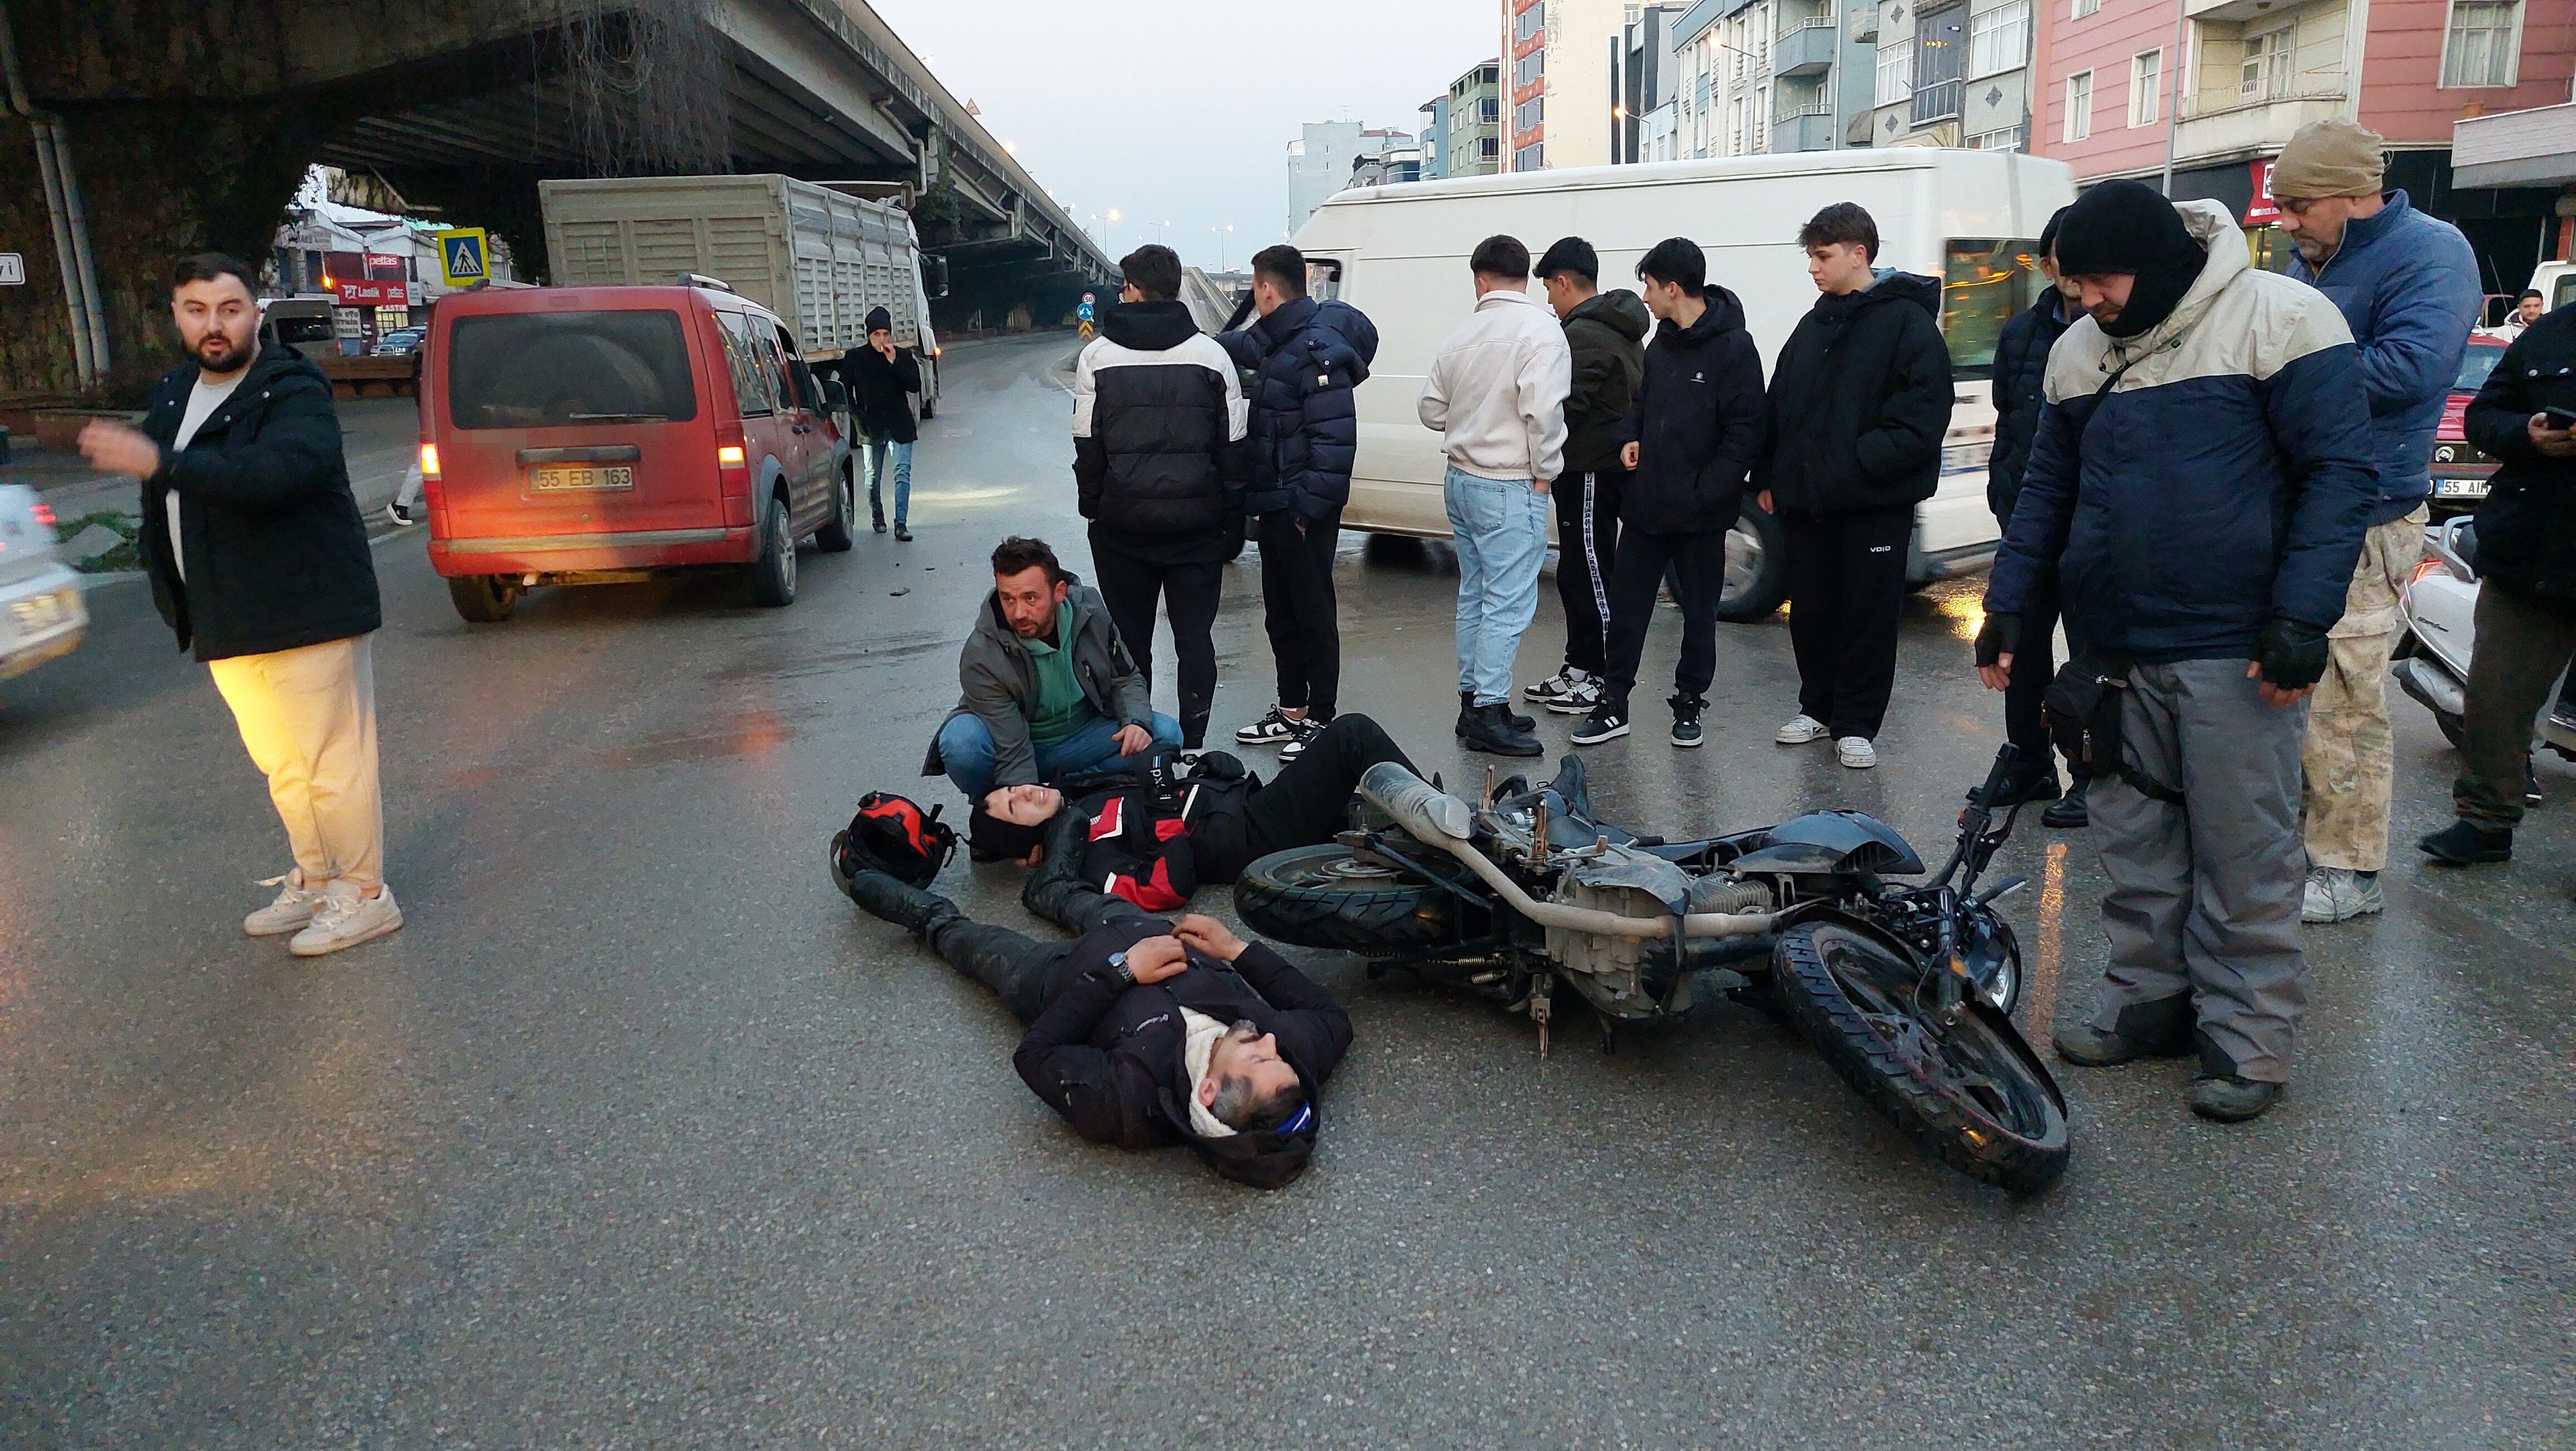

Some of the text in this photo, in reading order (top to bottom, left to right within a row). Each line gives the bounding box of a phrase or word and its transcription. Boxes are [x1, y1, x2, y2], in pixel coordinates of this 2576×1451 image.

[539, 469, 631, 488] 55 EB 163
[2445, 481, 2460, 493] 55
